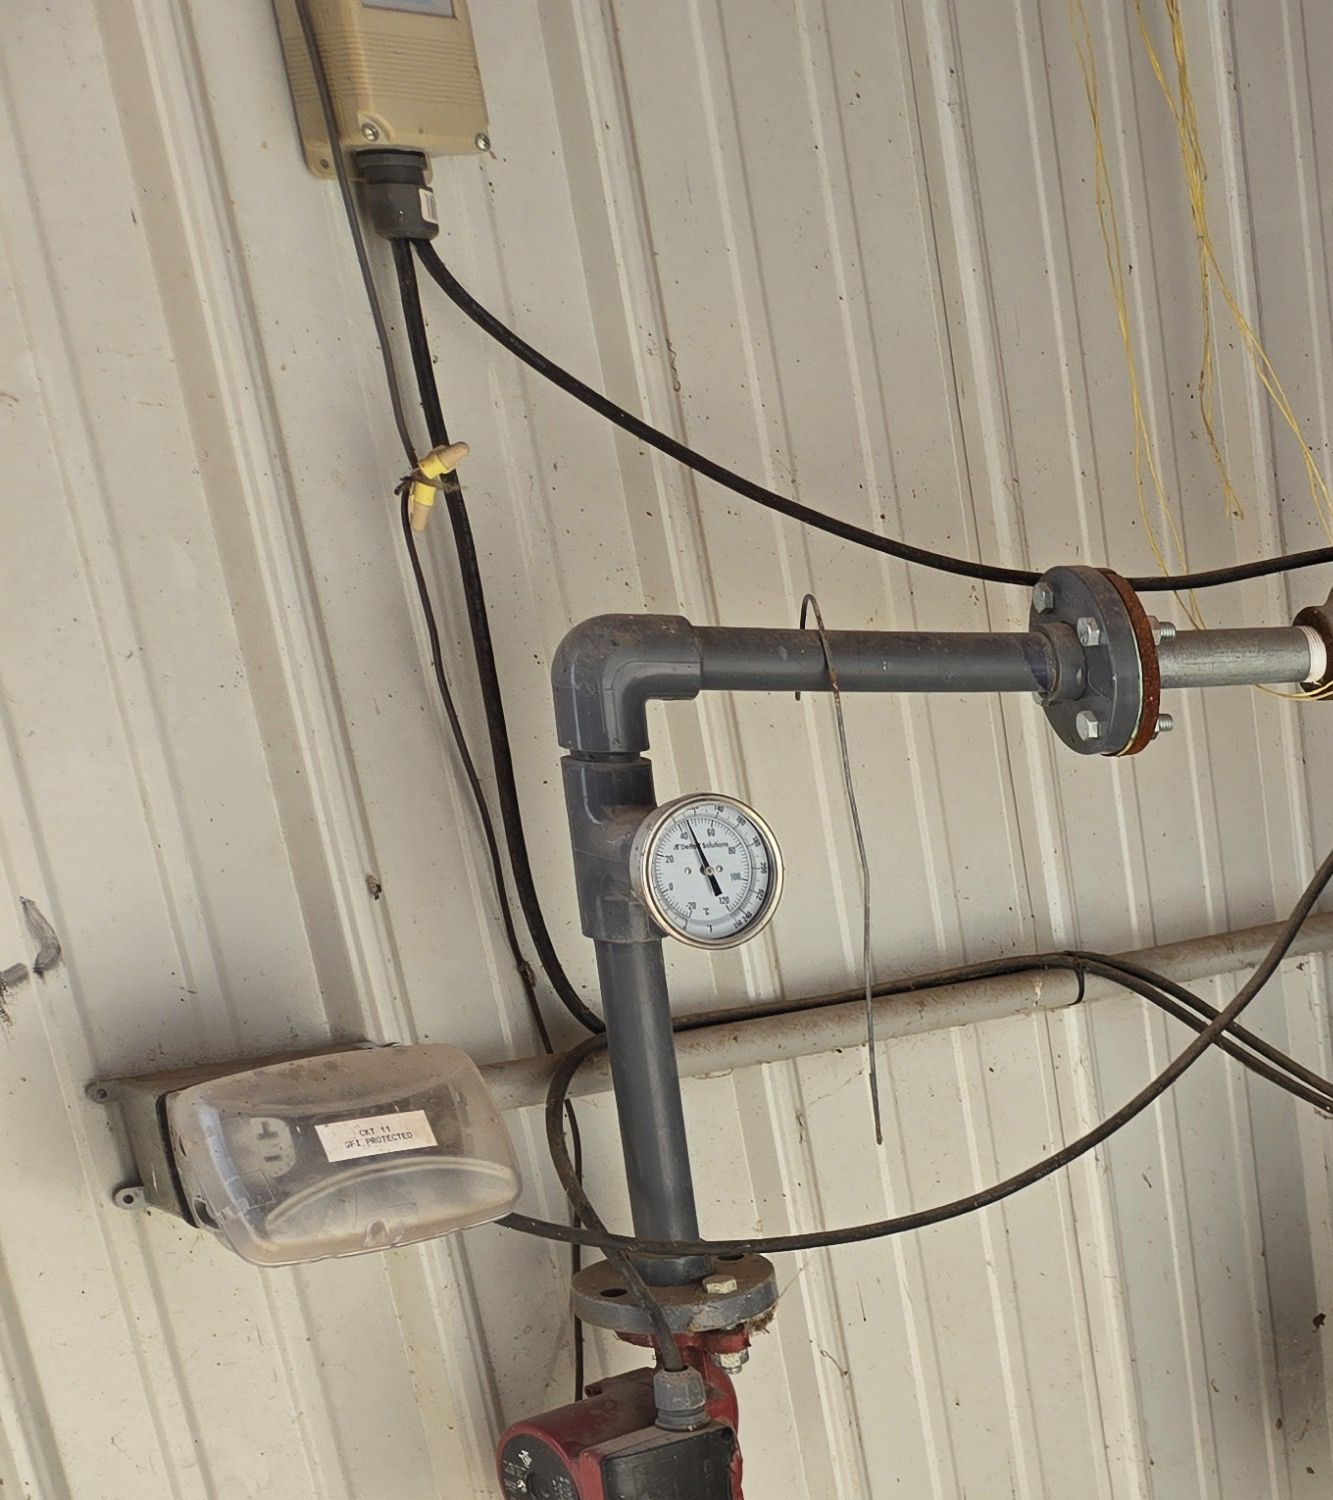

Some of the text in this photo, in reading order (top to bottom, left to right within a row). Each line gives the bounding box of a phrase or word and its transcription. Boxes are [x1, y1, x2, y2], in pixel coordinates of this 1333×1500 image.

[665, 855, 674, 863] 20
[359, 1128, 375, 1137] CKT
[365, 1131, 413, 1145] PROTECTED
